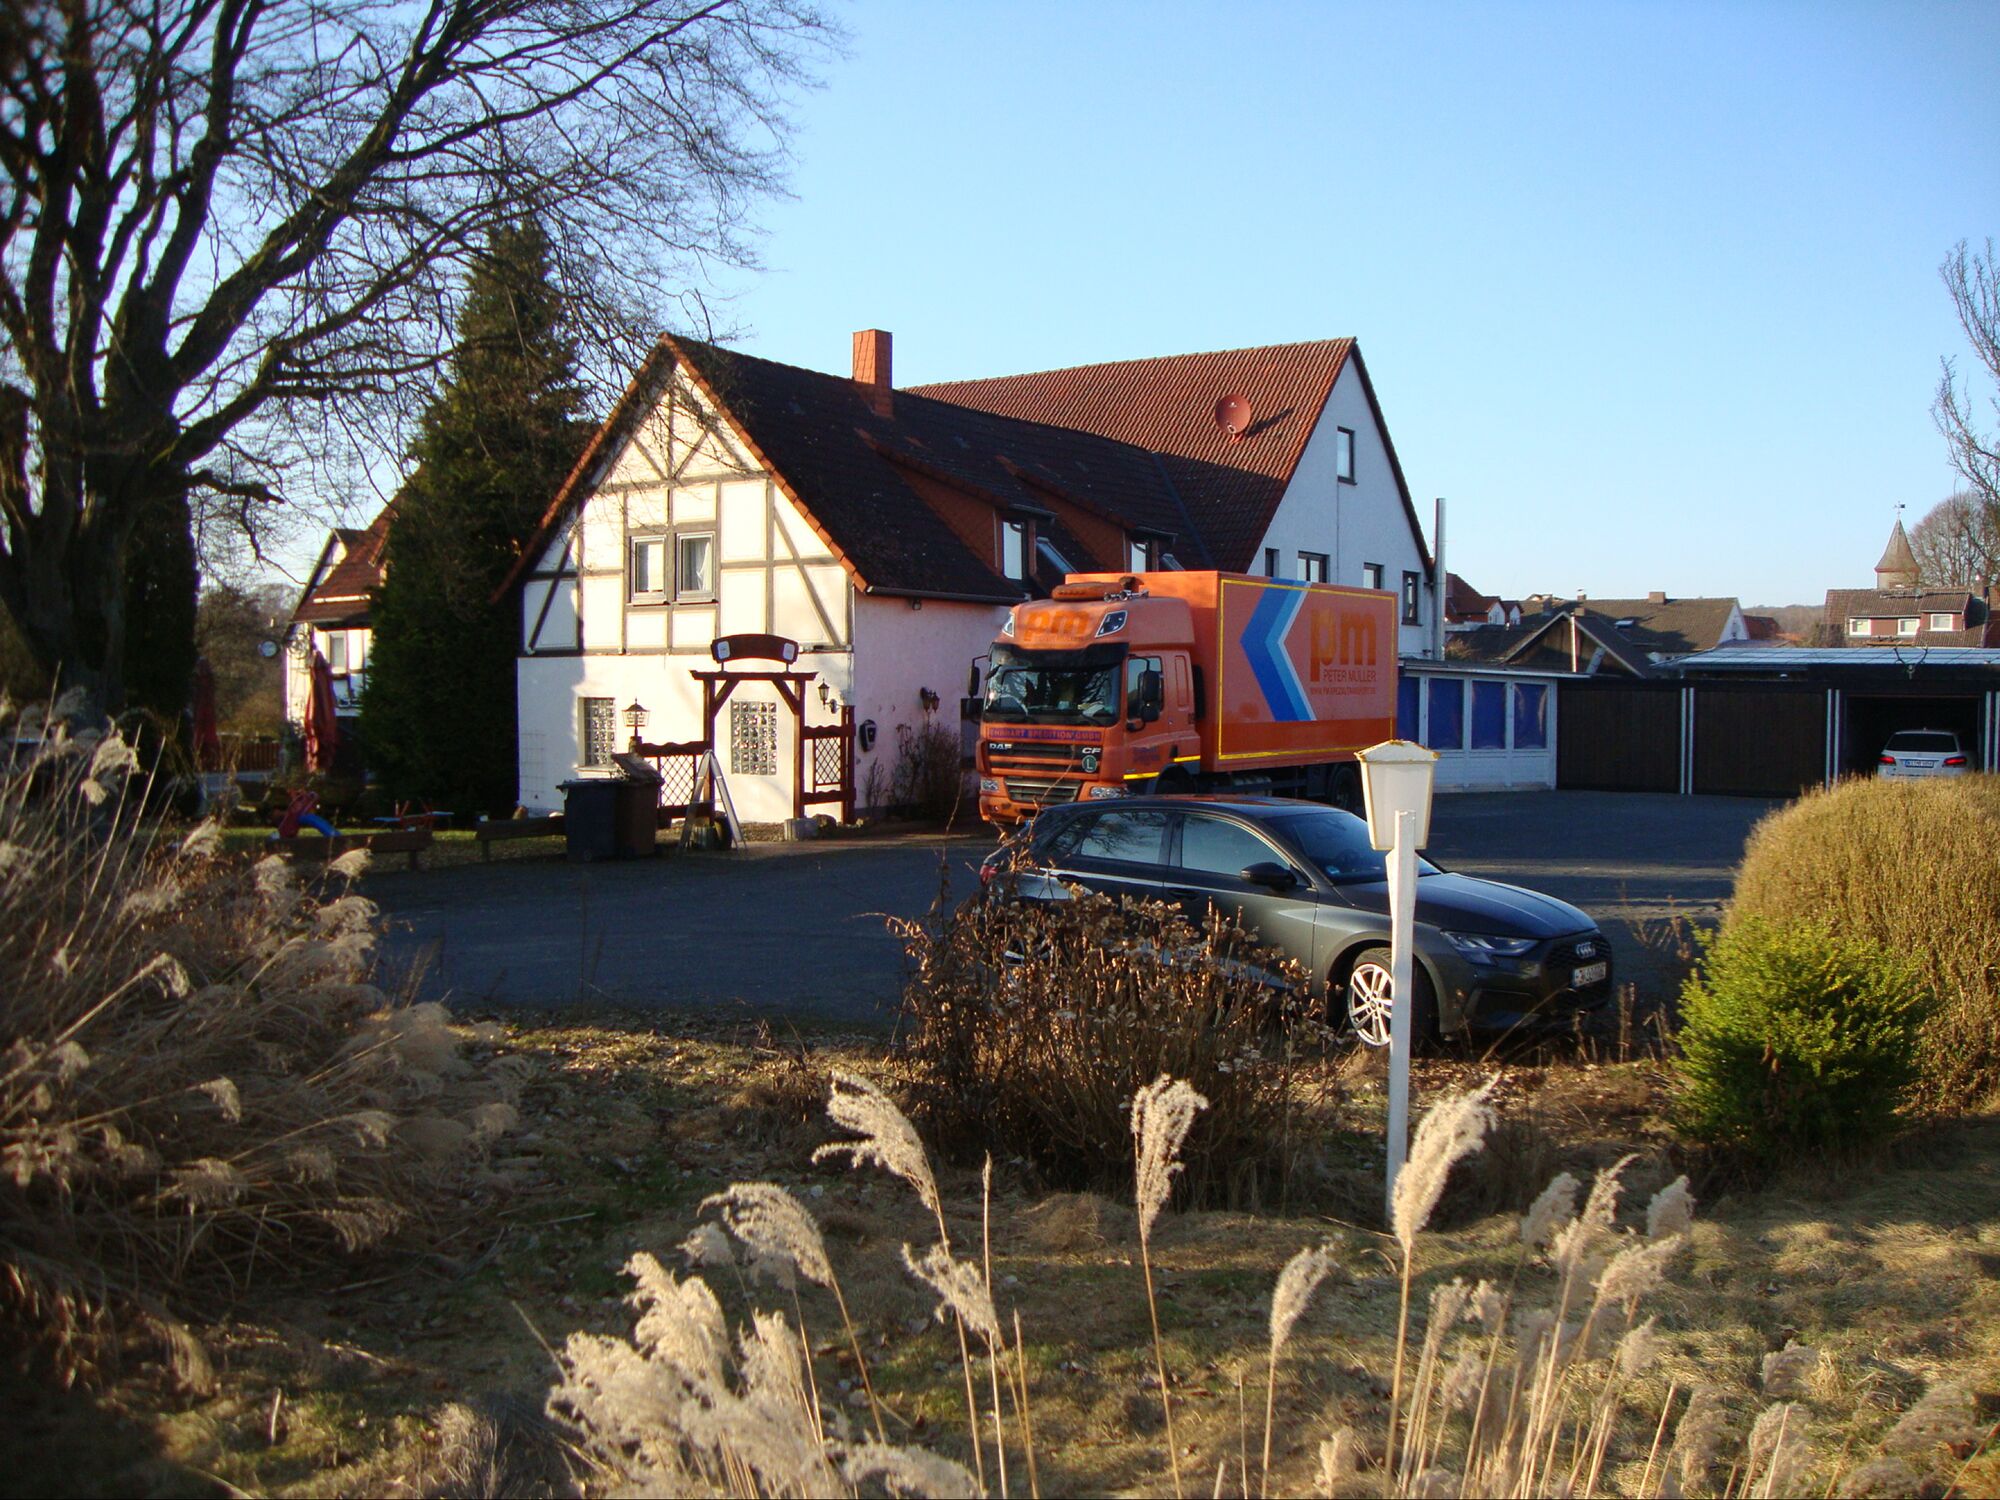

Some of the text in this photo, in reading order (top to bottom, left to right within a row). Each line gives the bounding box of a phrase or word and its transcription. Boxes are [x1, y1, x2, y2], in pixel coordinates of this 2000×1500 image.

[1023, 610, 1090, 642] pm
[1310, 607, 1377, 682] pm
[1323, 669, 1347, 682] PETER
